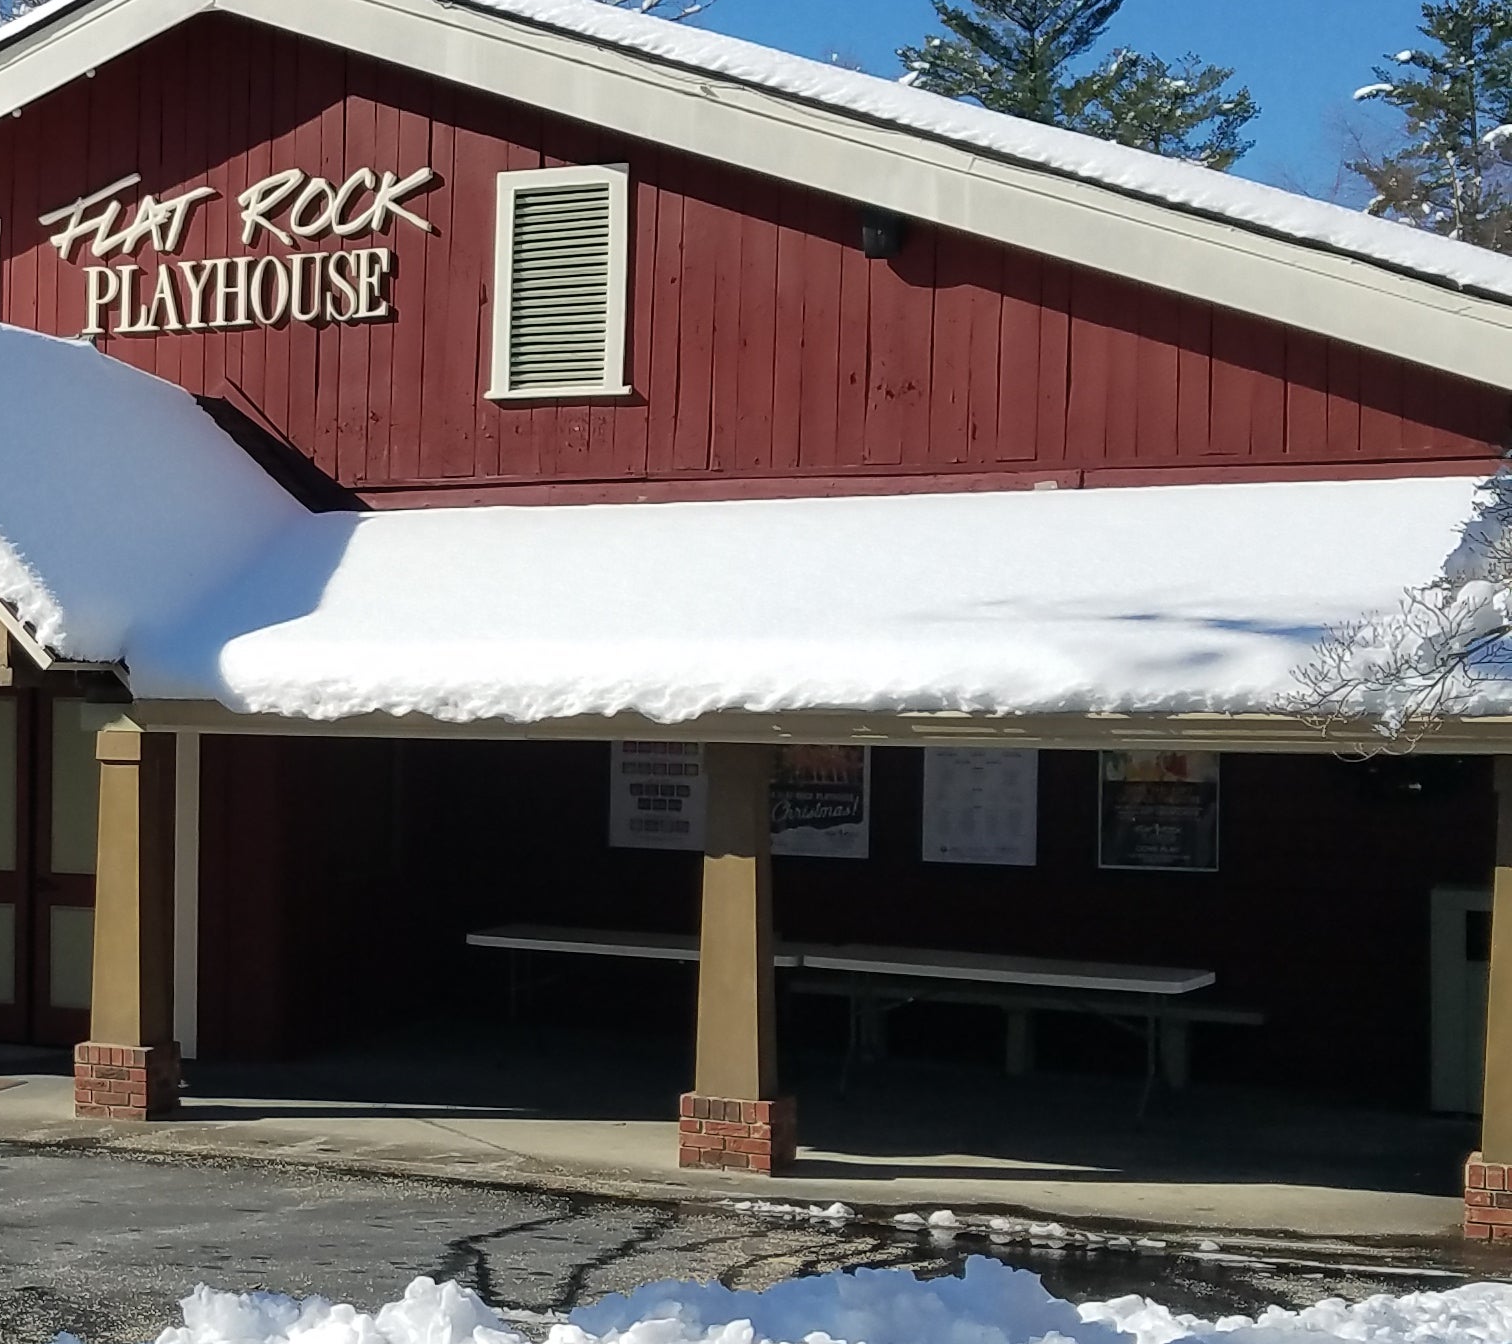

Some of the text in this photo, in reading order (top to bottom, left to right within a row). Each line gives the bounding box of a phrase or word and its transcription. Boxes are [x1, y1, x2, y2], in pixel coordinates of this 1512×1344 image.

[39, 167, 434, 258] FLAT ROCK
[81, 247, 390, 336] PLAYHOUSE
[772, 796, 859, 822] Christmas!
